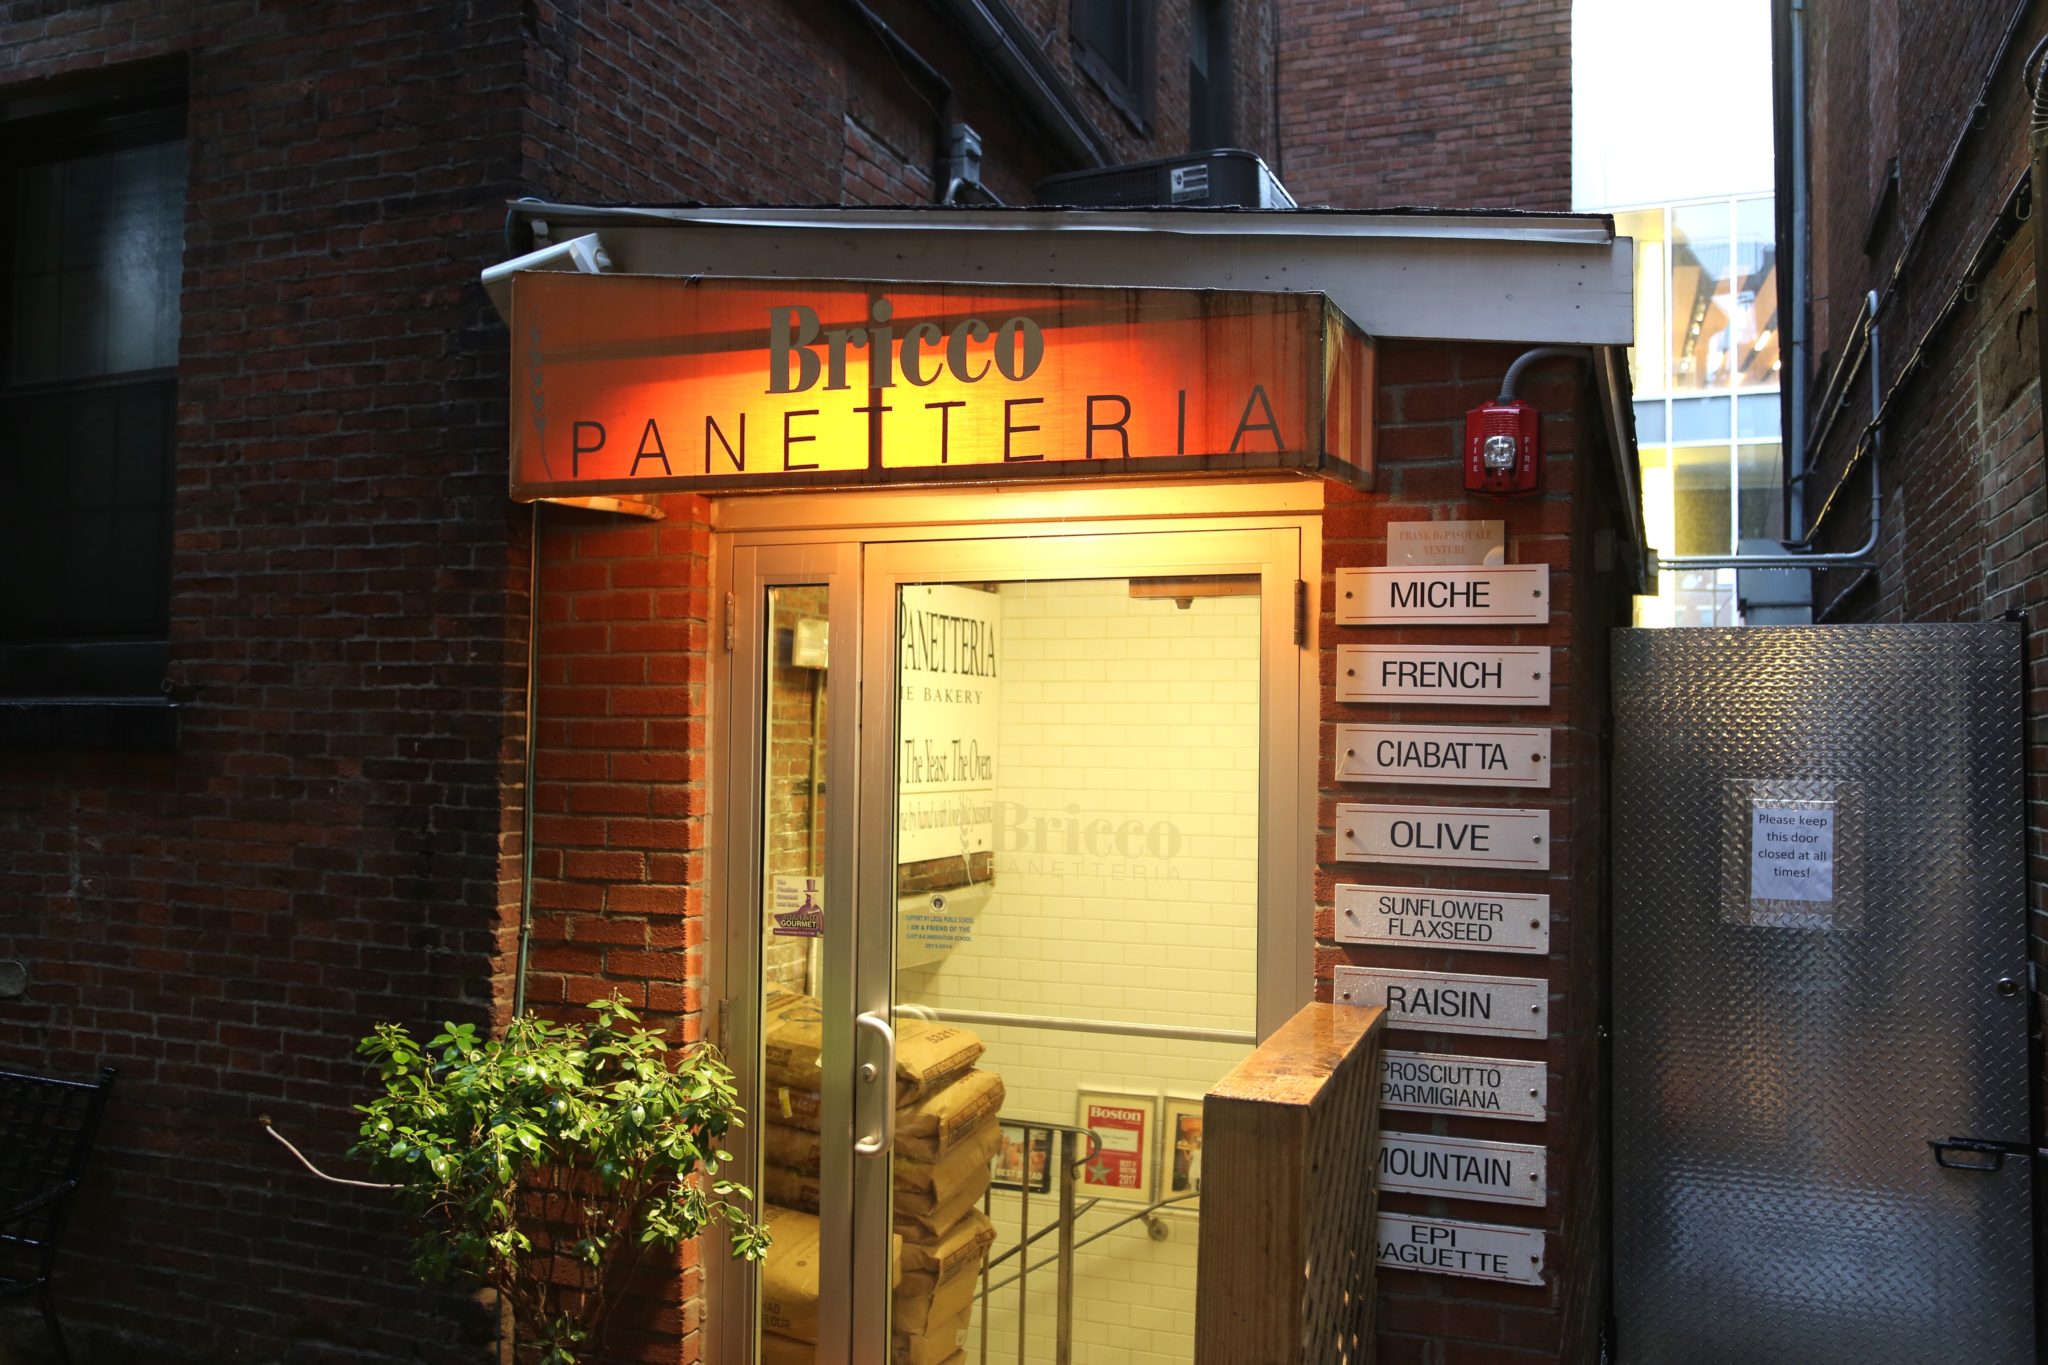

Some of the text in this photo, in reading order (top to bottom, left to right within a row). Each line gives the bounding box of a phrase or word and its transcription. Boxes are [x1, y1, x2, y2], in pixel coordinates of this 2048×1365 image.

[764, 298, 1044, 395] Bricco
[572, 384, 1286, 478] PANETTERIA
[1390, 581, 1490, 609] MICHE
[1381, 661, 1502, 689] FRENCH
[923, 686, 983, 705] BAKERY
[1376, 739, 1509, 771] CIABATTA
[985, 800, 1182, 861] Bricco
[1759, 814, 1828, 828] Please keep
[1390, 820, 1490, 852] OLIVE
[1767, 832, 1819, 843] this door
[1758, 850, 1827, 861] closed at all
[1774, 868, 1810, 877] times!
[1378, 896, 1503, 921] SUNFLOWER
[780, 919, 817, 928] GOURMET
[1388, 918, 1493, 942] FLAXSEED
[1386, 985, 1491, 1020] RAISIN
[1380, 1083, 1501, 1111] PARMIGIANA
[1090, 1106, 1142, 1122] Boston
[1119, 1174, 1136, 1185] 2017
[1410, 1225, 1457, 1247] EPI
